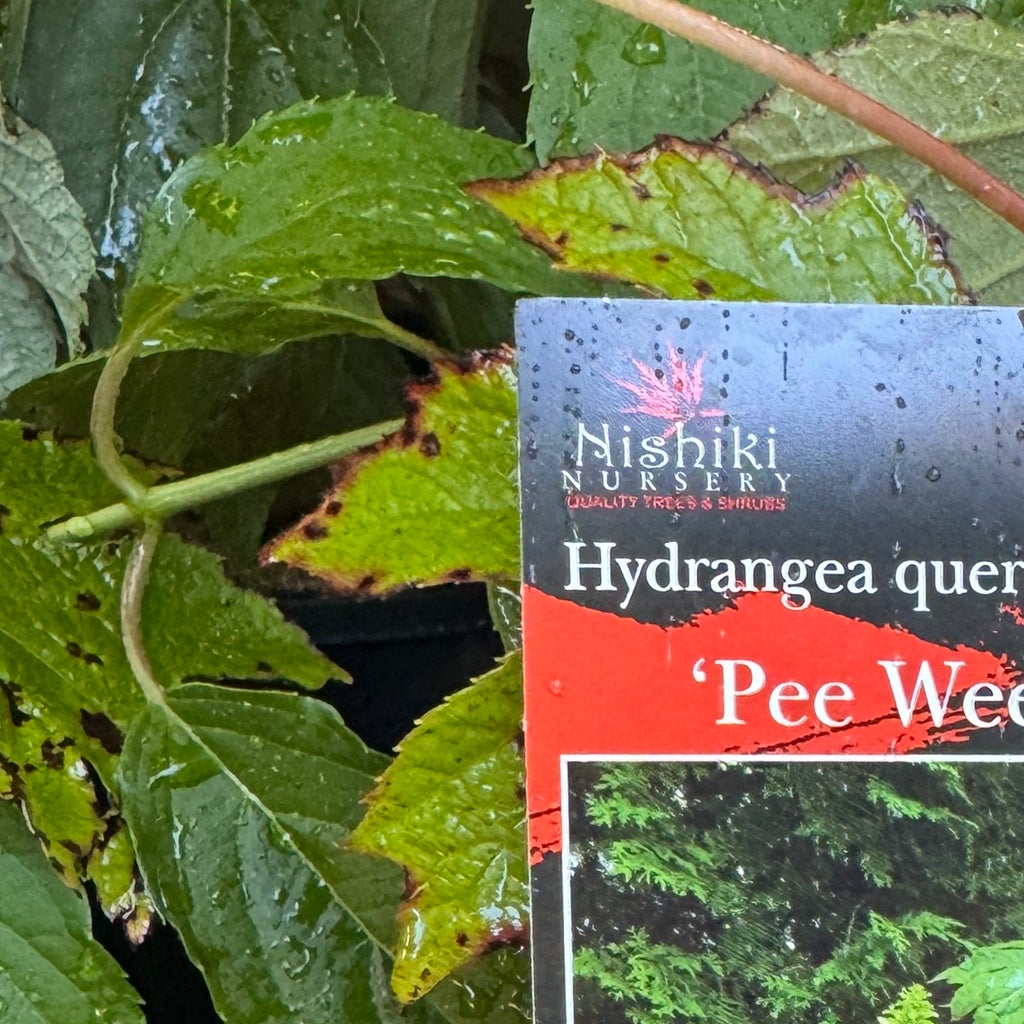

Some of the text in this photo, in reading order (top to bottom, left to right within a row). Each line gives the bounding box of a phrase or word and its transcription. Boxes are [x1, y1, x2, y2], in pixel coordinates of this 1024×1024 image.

[576, 422, 778, 470] Nishiki
[561, 471, 791, 492] NURSERY
[566, 495, 637, 510] QUALITY
[564, 541, 878, 611] Hydrangea
